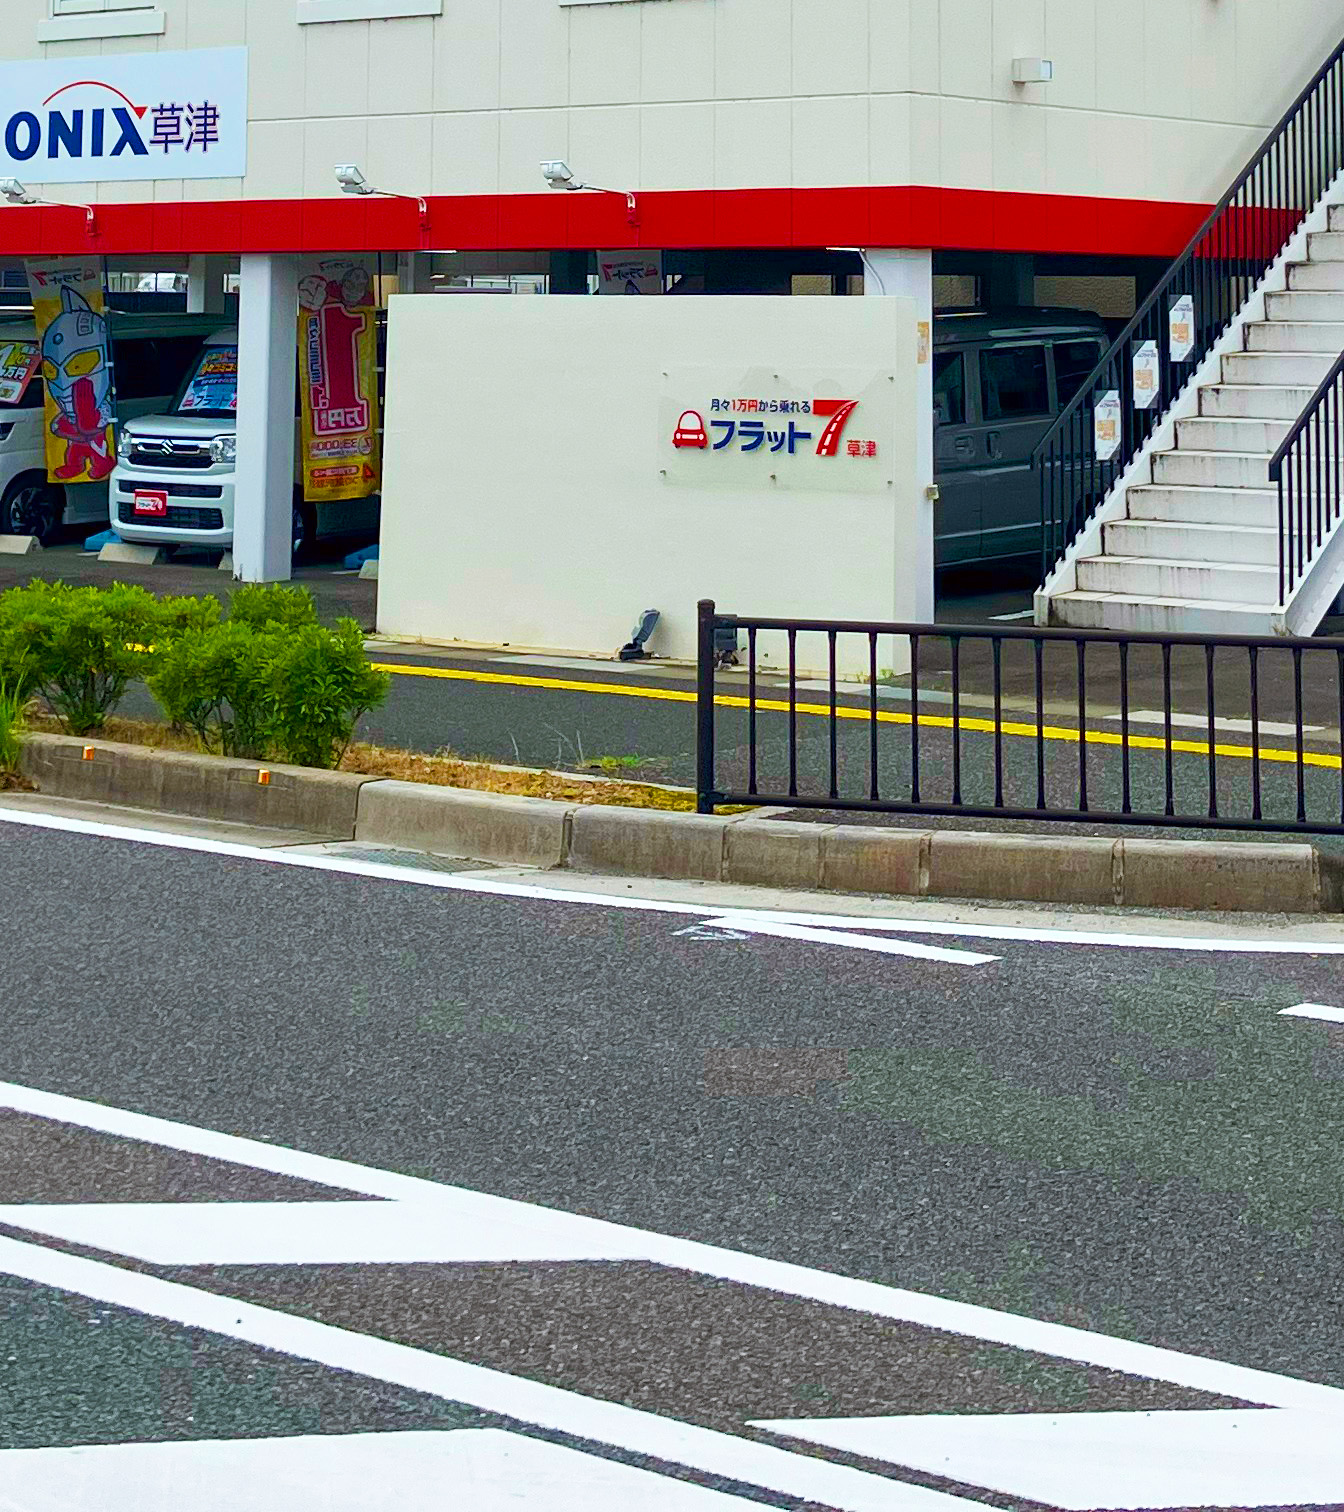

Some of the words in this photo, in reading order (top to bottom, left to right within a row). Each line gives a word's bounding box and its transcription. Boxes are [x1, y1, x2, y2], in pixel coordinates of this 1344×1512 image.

[4, 105, 149, 161] ONIX
[149, 100, 220, 155] 草津
[711, 399, 811, 414] 月々1万円から乗れる
[847, 439, 877, 458] 草津
